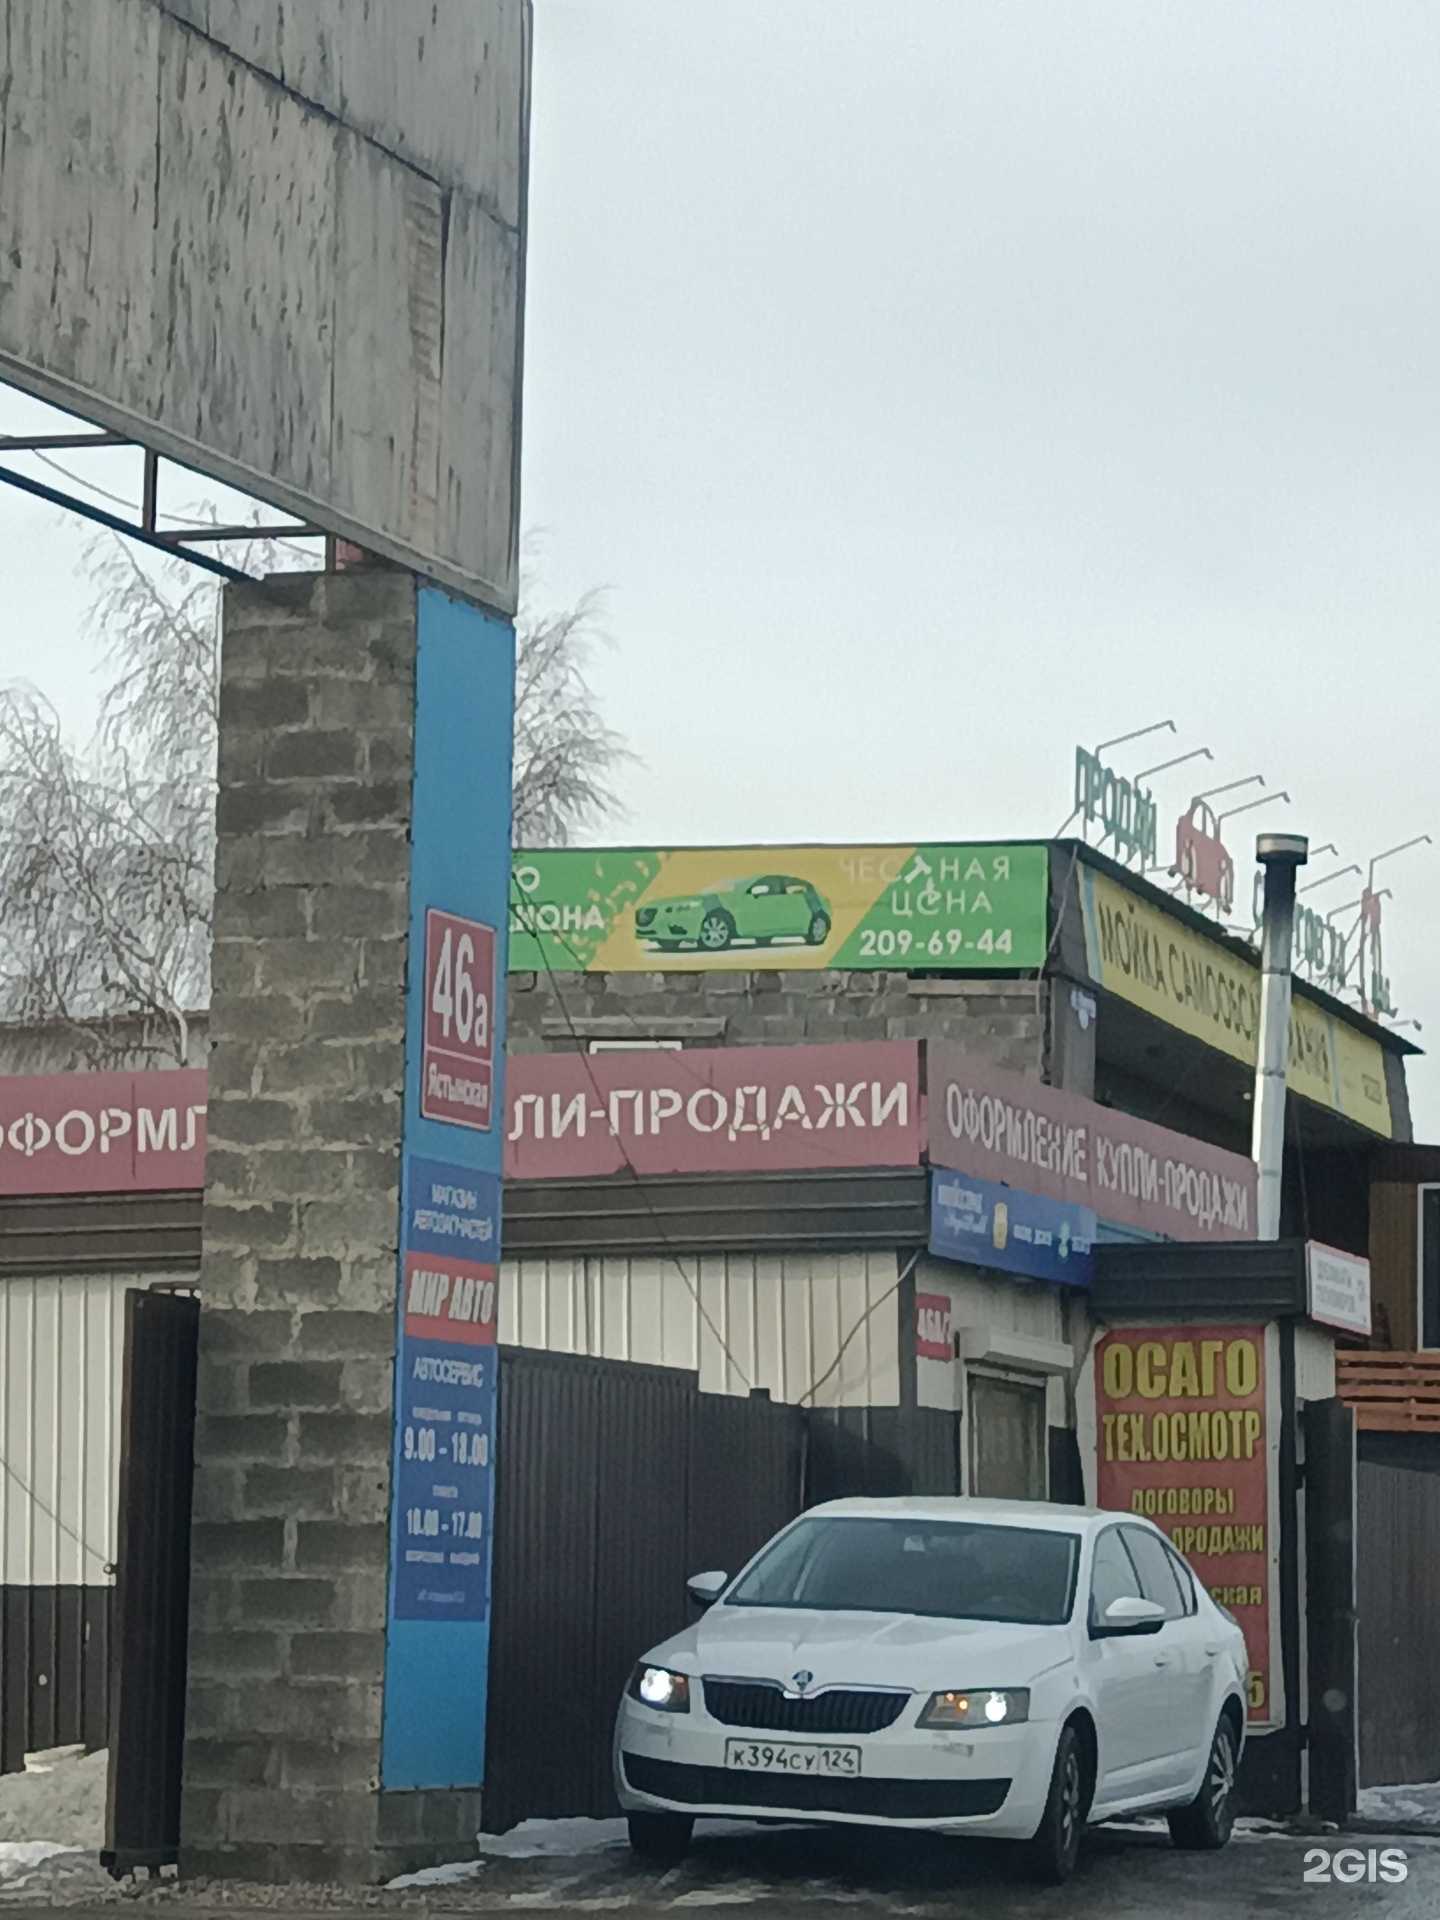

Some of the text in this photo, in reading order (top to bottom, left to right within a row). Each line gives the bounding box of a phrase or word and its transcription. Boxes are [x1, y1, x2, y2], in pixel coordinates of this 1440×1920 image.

[859, 928, 1013, 956] 209-69-44
[0, 1105, 207, 1157] ФОРМЛ
[946, 1083, 1249, 1230] ОФОРМЛЕНИЕ КУПЛИ-ПРОДАЖИ
[408, 1269, 495, 1325] МИР АВТО
[413, 1357, 484, 1388] АВТОСЕРВИС
[1102, 1339, 1258, 1399] ОСАГО
[1102, 1410, 1261, 1463] ТЕХ.ОСМОТР
